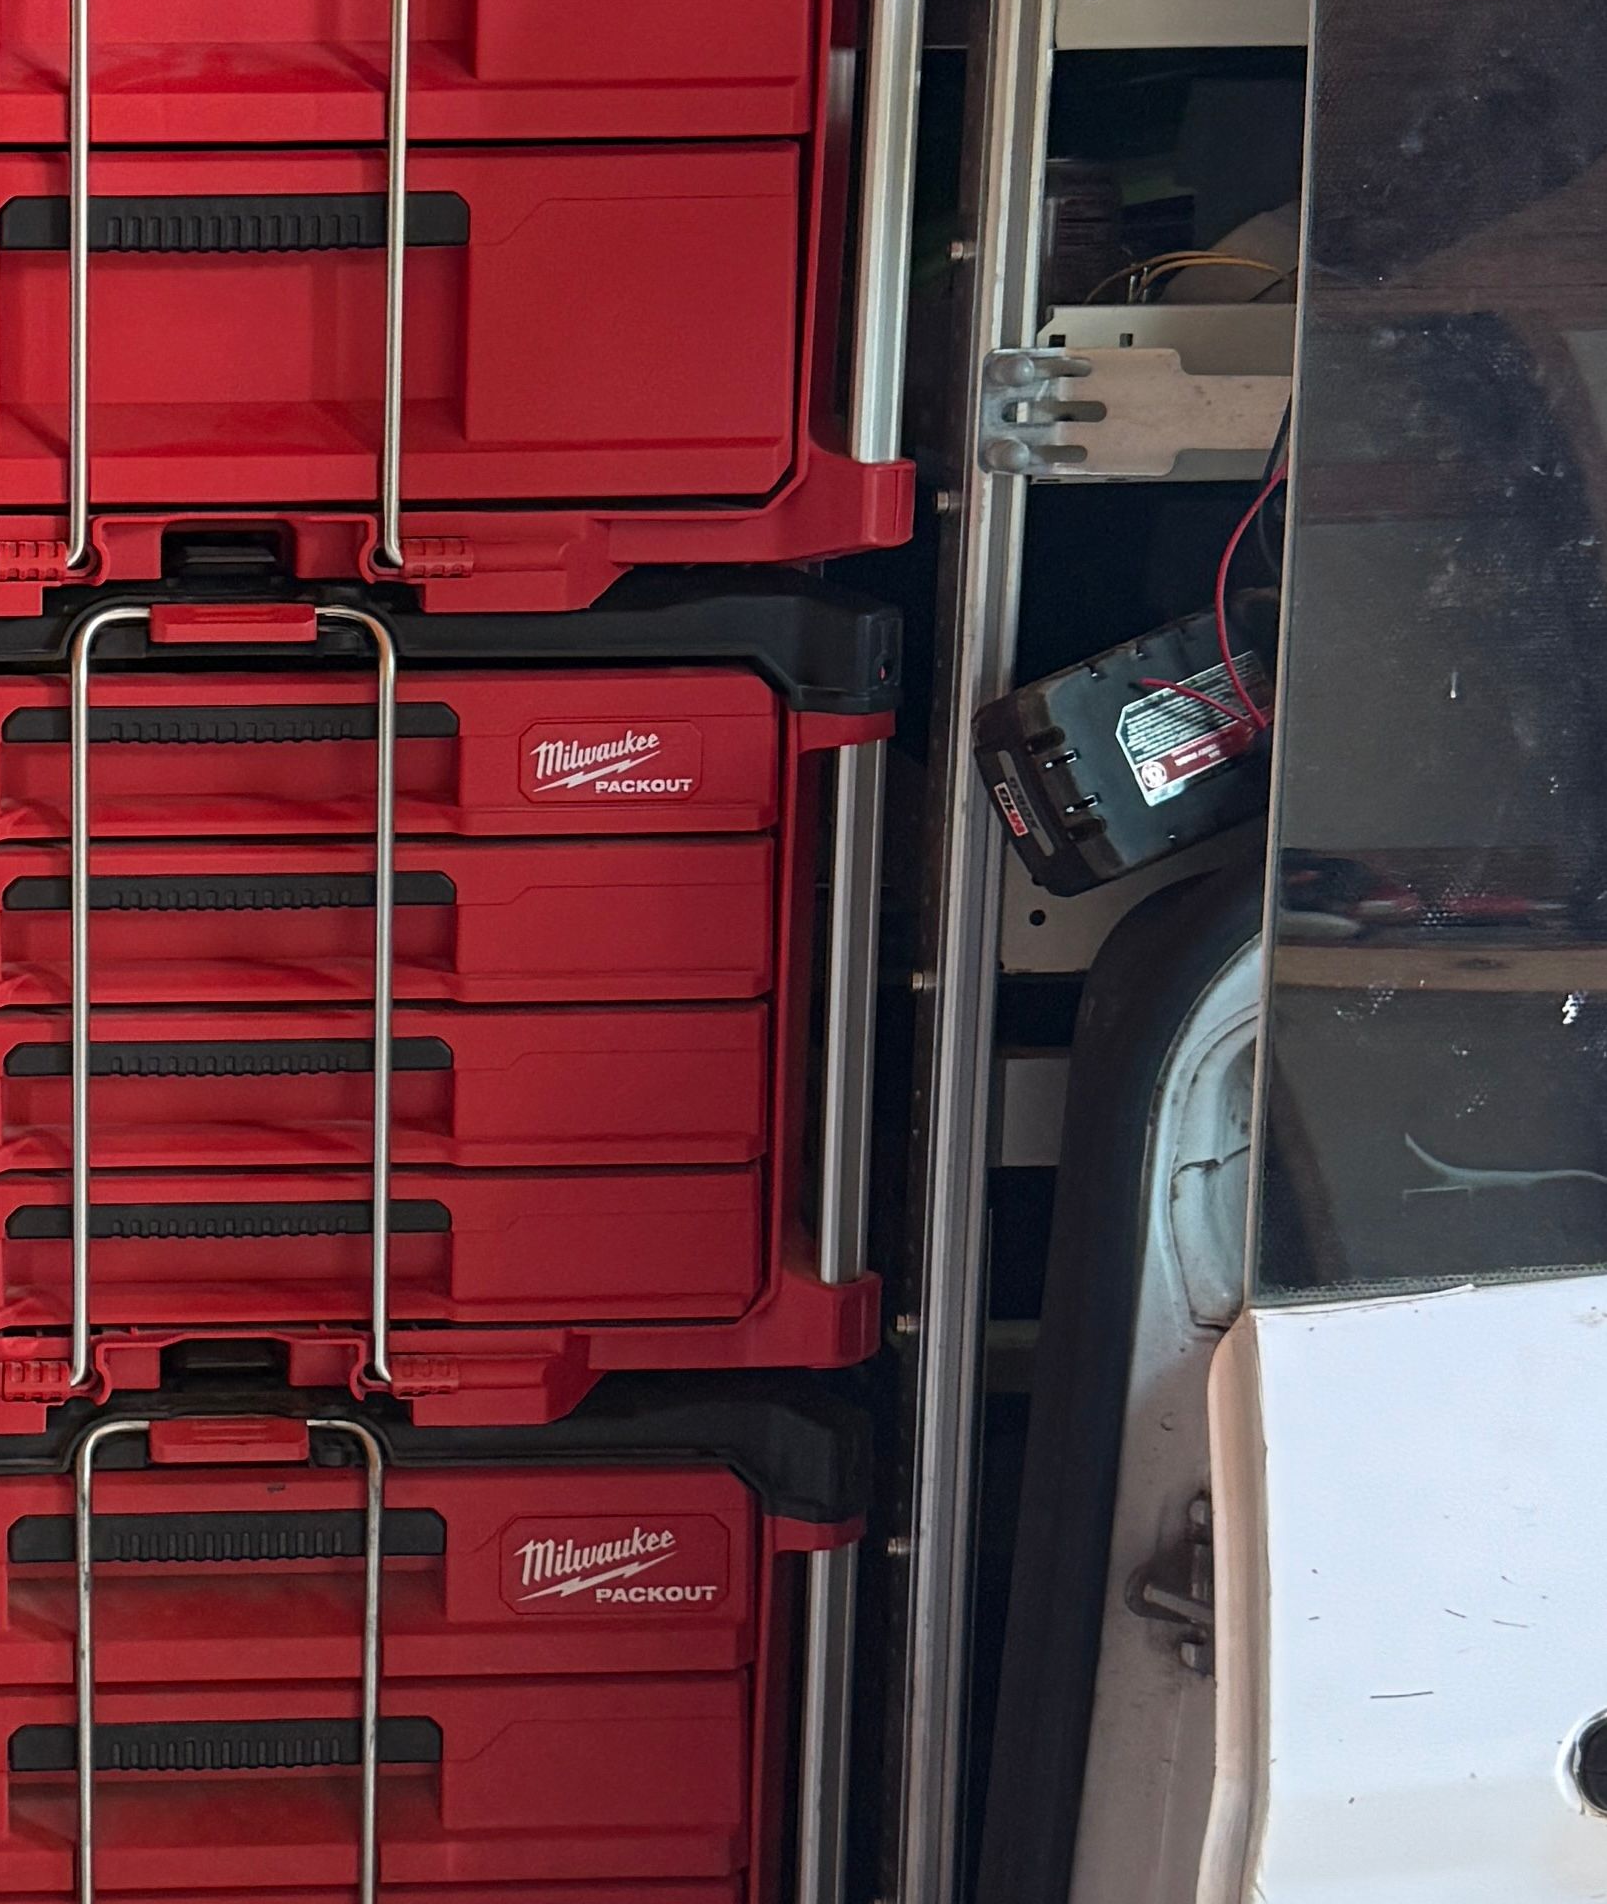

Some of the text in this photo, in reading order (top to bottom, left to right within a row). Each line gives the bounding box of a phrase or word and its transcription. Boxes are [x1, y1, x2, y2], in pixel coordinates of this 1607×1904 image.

[529, 729, 661, 780] Milwaukee
[594, 778, 693, 794] PACKOUT
[514, 1526, 676, 1586] Milwaukee
[595, 1586, 718, 1604] PACKOUT
